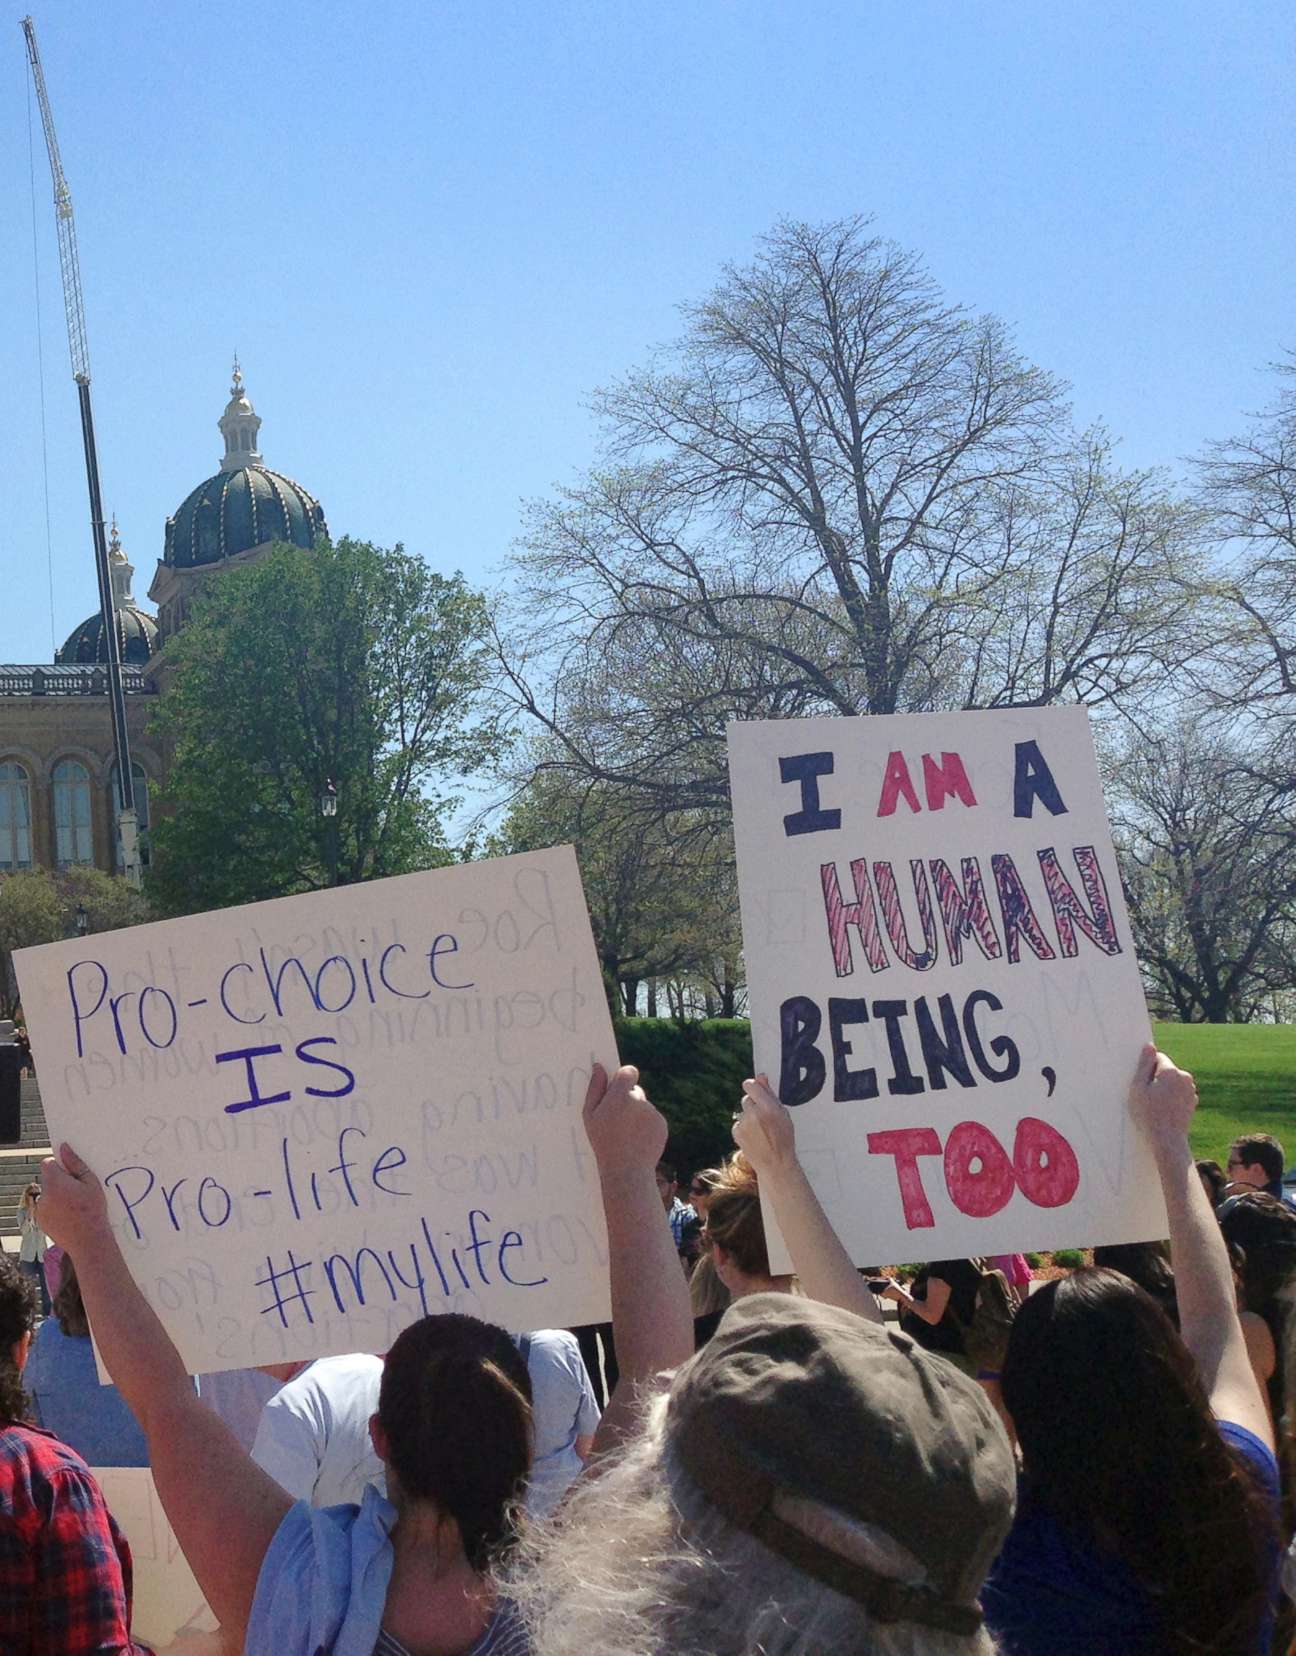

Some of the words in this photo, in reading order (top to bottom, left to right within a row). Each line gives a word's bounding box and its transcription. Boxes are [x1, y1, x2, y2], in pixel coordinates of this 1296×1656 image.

[779, 751, 841, 836] I
[877, 750, 978, 818] AM
[1013, 739, 1069, 819] A
[820, 845, 1123, 978] HUMAN
[66, 933, 475, 1058] Pro-choice
[779, 989, 1057, 1107] BEING,
[215, 1036, 356, 1114] IS
[105, 1127, 413, 1240] Pro-life
[867, 1117, 1081, 1230] TOO
[254, 1209, 549, 1328] #mylife
